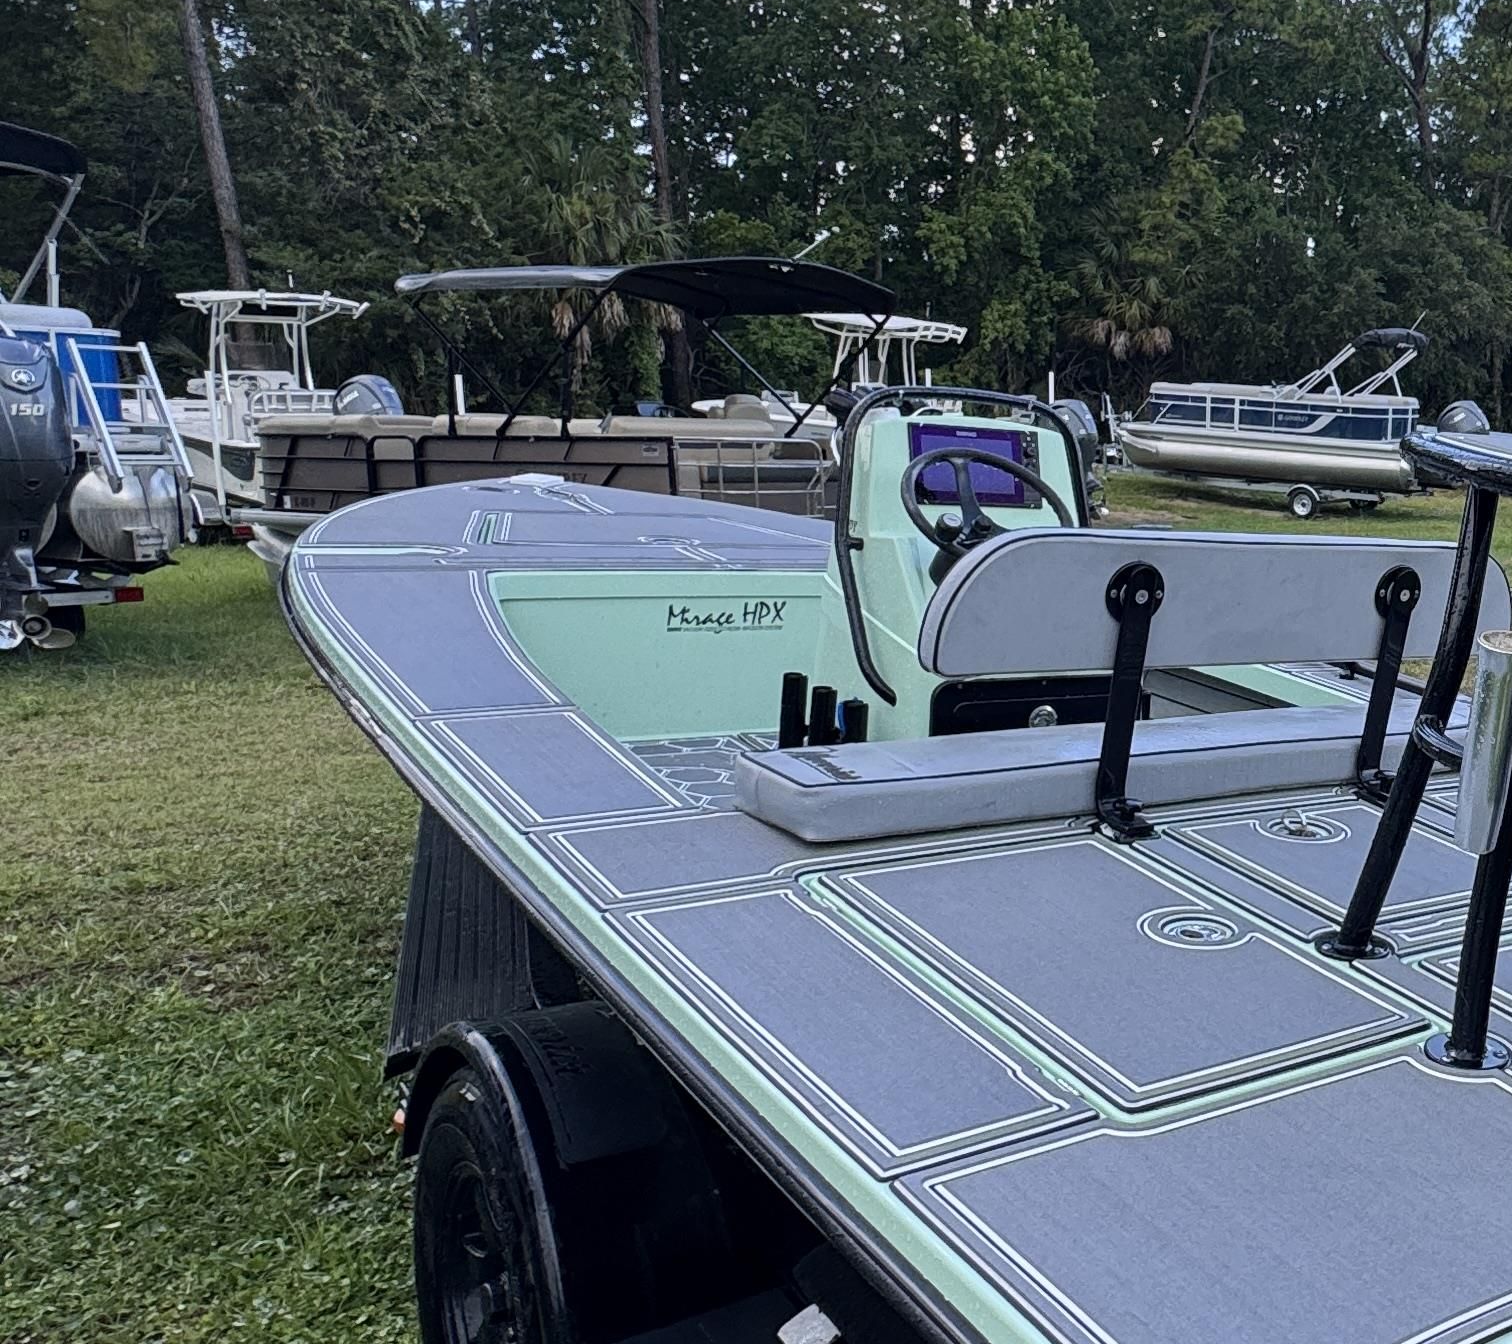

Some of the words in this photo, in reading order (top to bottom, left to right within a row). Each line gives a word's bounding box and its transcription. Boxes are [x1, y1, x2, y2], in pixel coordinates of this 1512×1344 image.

[10, 403, 45, 417] 150
[667, 603, 736, 634] Mirage
[743, 600, 787, 625] HPX
